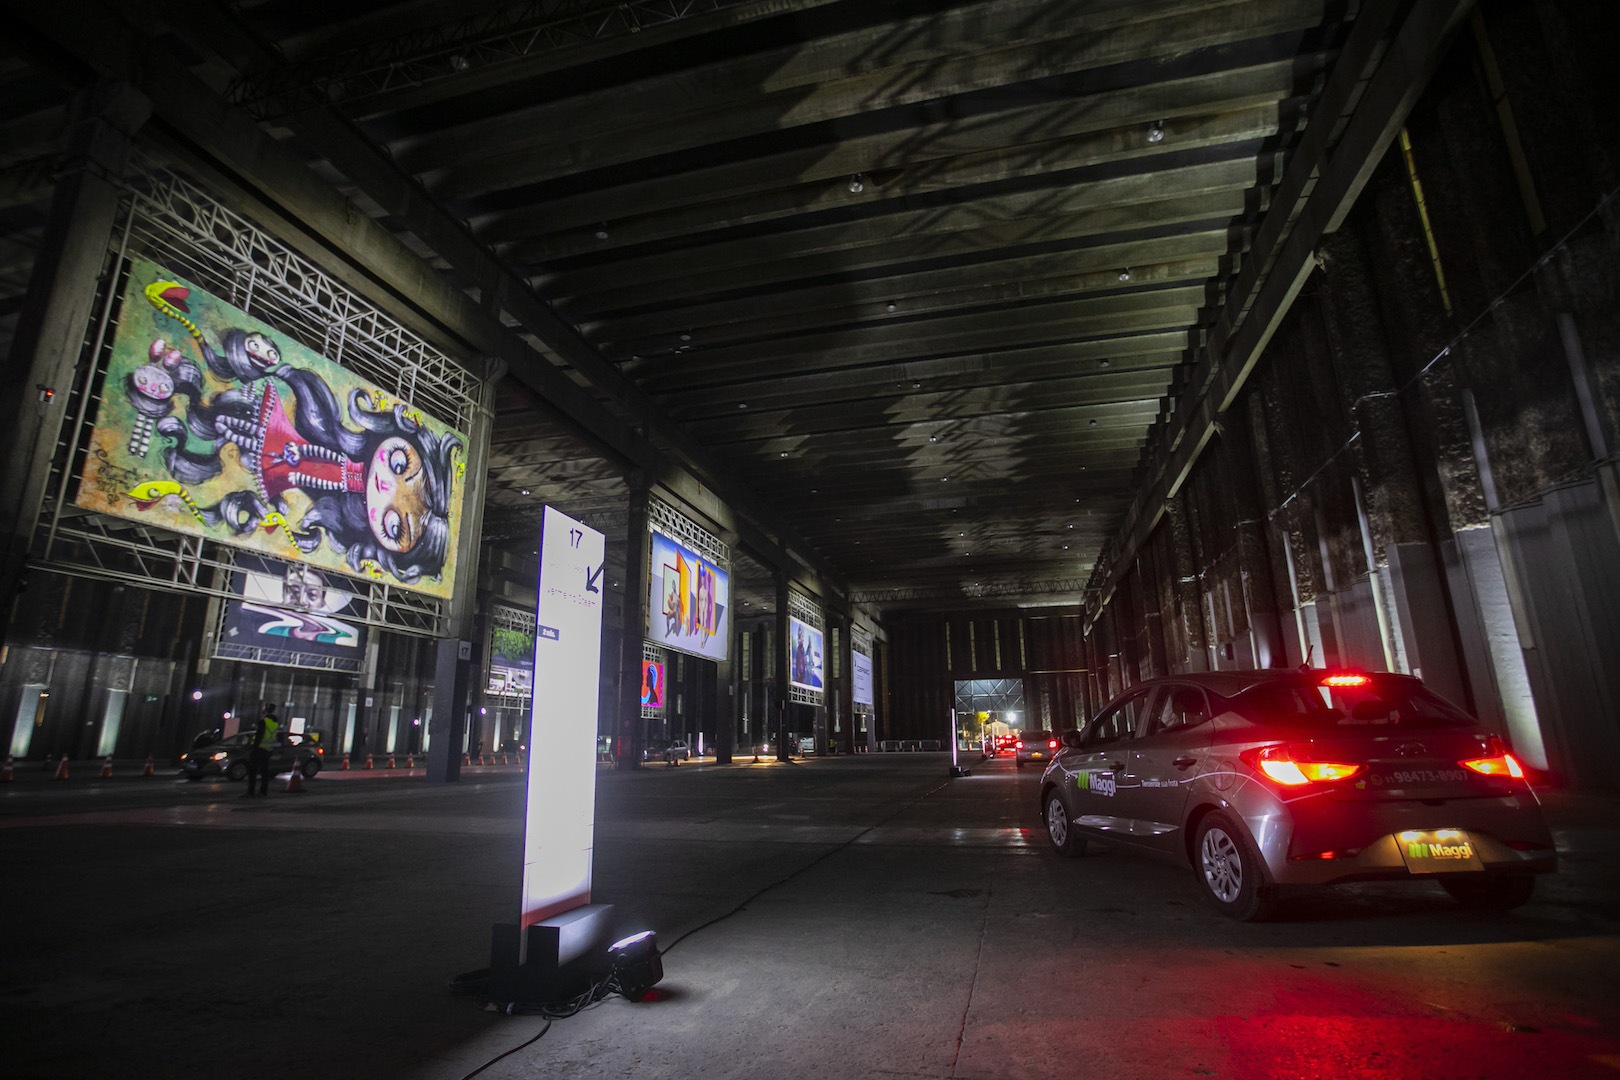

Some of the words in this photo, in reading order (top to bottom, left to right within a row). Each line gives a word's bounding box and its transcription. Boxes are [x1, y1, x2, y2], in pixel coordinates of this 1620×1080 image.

[569, 527, 583, 549] 17
[461, 646, 469, 657] 17
[1089, 773, 1116, 797] Maggi
[1394, 770, 1468, 784] 98473-8907
[1429, 841, 1473, 859] Maggi
